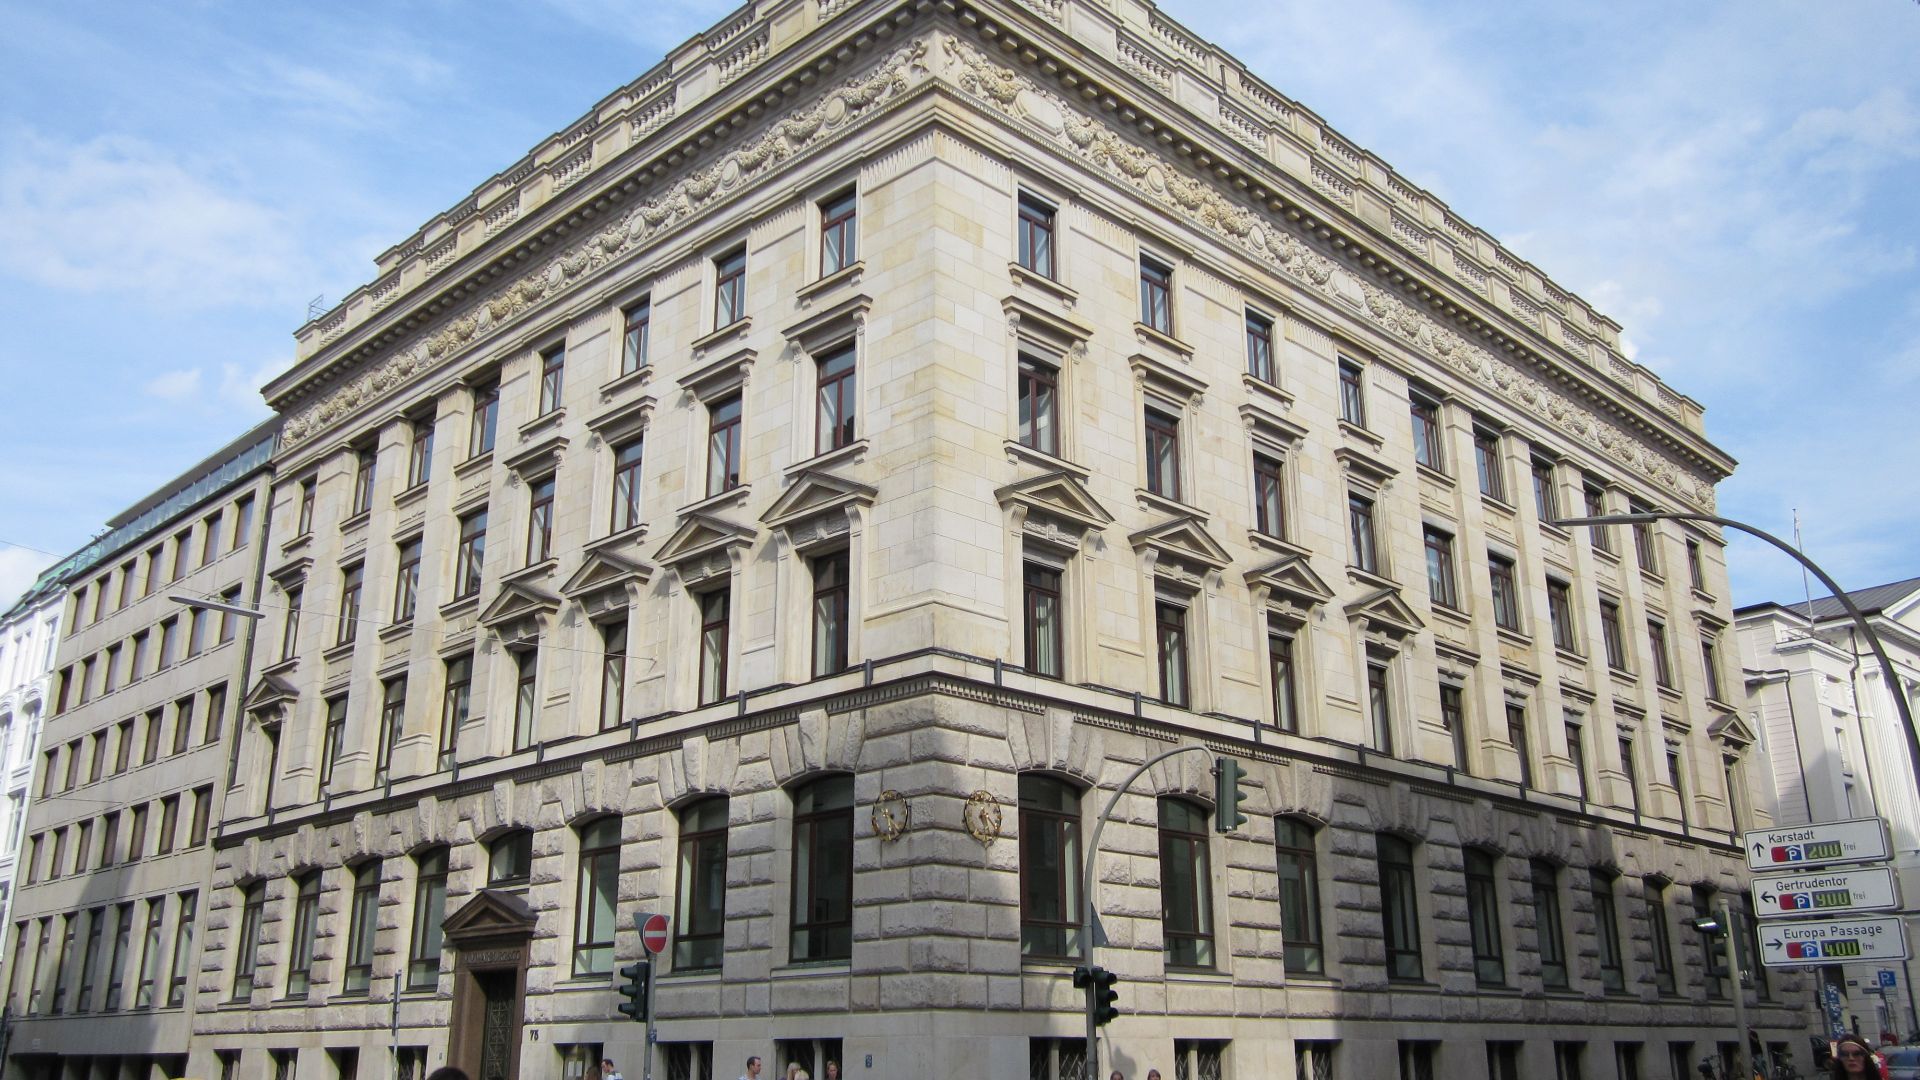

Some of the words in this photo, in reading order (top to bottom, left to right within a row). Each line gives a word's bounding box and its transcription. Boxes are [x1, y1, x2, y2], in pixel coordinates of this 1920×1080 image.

[1768, 830, 1815, 843] Karstadt
[1789, 851, 1797, 861] P
[1844, 842, 1856, 851] frei
[1776, 877, 1848, 891] Gertrudentor
[1797, 898, 1805, 909] P
[1853, 891, 1866, 899] frei
[1783, 928, 1826, 939] Europa
[1830, 925, 1882, 937] Passage
[1806, 947, 1815, 957] P
[1862, 942, 1874, 951] frei
